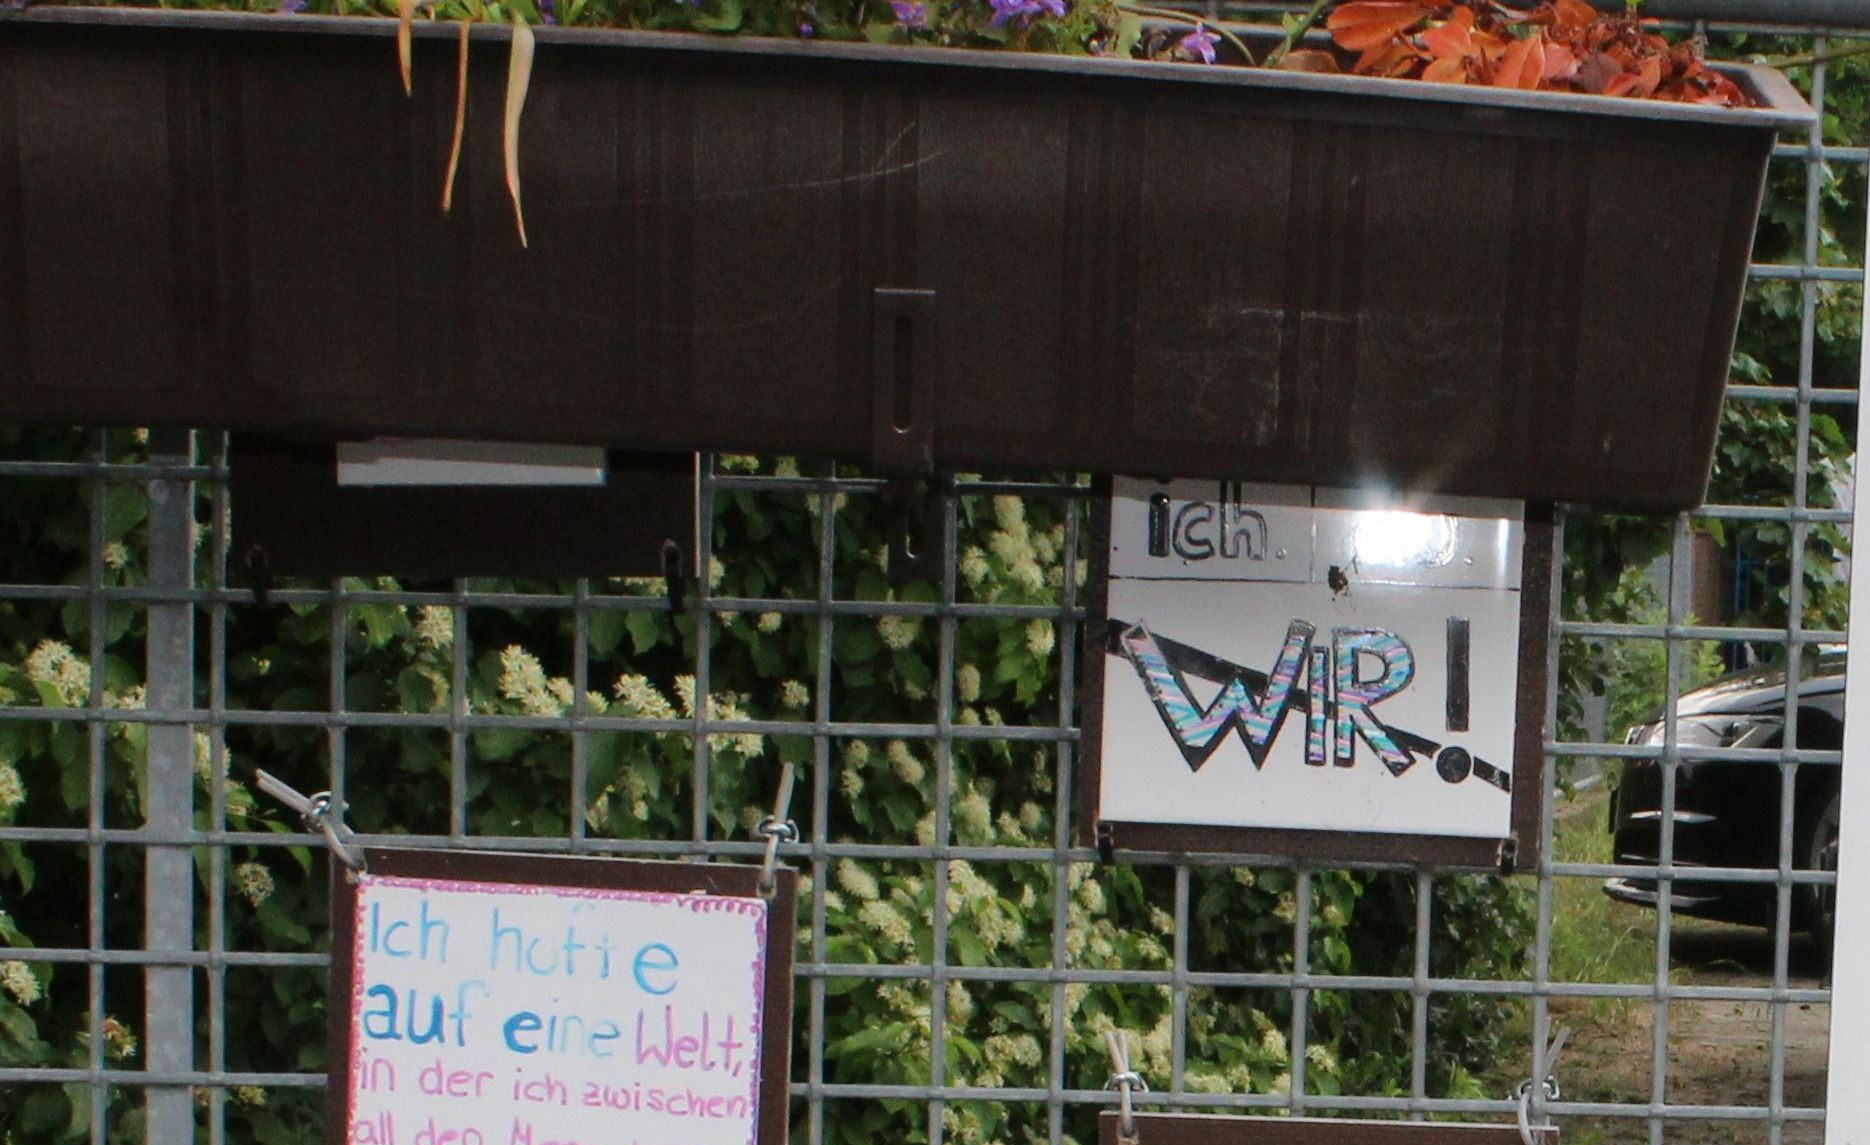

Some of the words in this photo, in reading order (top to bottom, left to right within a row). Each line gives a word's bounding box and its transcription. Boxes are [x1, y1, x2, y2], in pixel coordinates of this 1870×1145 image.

[1120, 614, 1473, 784] WIR!
[369, 900, 449, 966] Ich
[362, 979, 491, 1048] auf
[503, 998, 622, 1058] eine
[635, 1003, 744, 1078] Welt,
[357, 1046, 396, 1092] in
[418, 1057, 495, 1098] der
[512, 1067, 568, 1106] ich
[581, 1081, 750, 1120] zwischen
